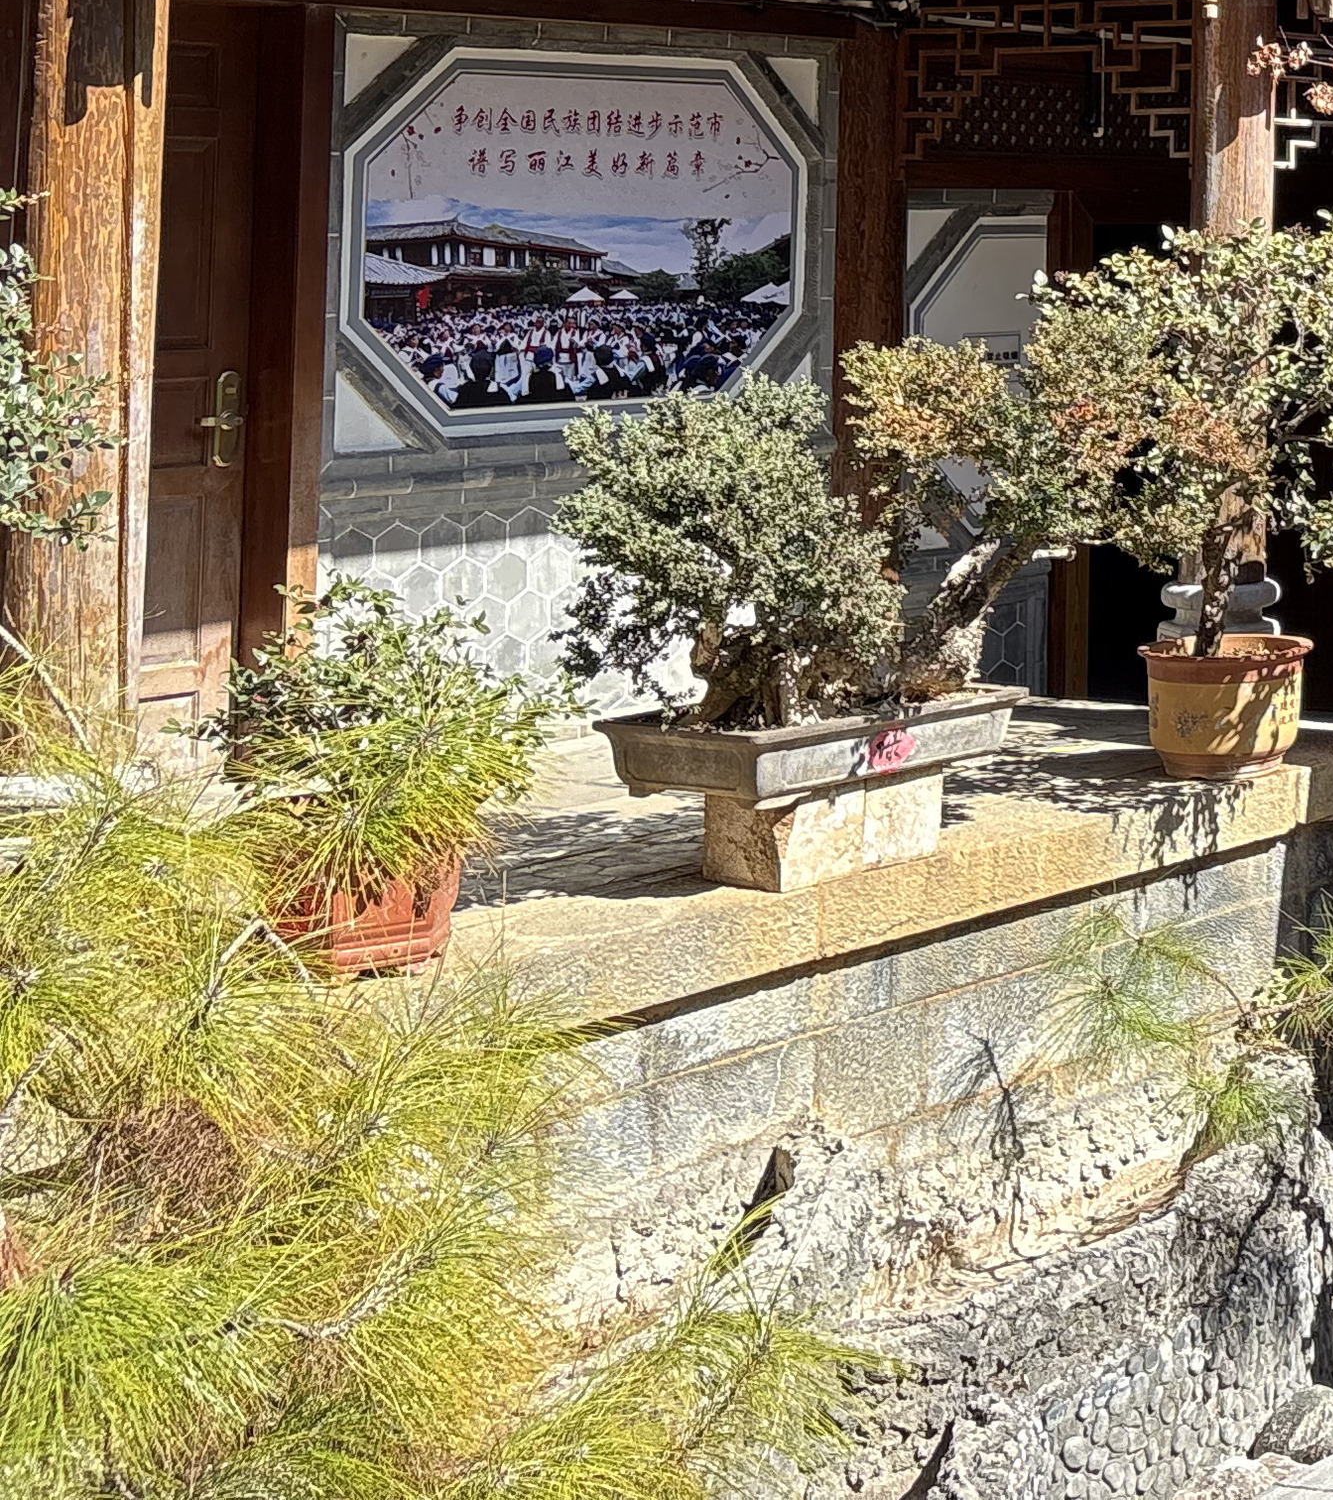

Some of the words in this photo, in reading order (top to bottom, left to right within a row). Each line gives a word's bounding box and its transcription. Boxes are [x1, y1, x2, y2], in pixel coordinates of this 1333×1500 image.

[451, 106, 725, 139] 争创全国民族团结进步示范市
[468, 149, 708, 181] 谱写丽江美好新篇章
